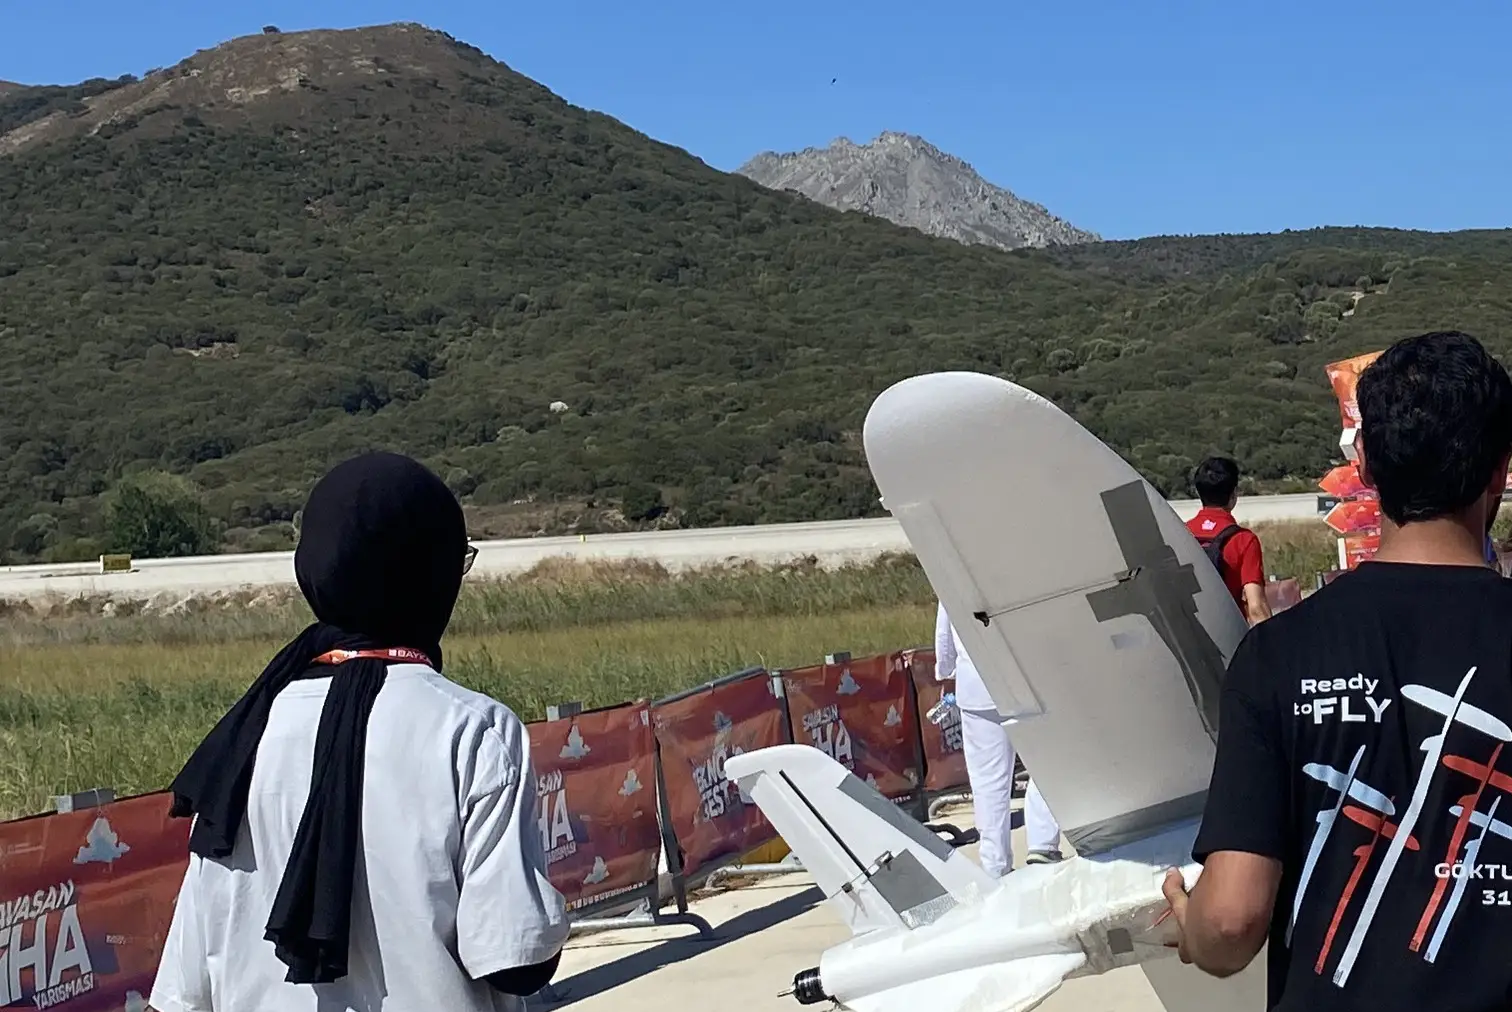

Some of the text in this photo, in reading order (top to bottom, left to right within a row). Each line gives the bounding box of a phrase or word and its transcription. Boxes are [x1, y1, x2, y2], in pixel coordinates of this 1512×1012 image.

[1301, 672, 1379, 695] Ready
[1294, 696, 1392, 724] to FLY
